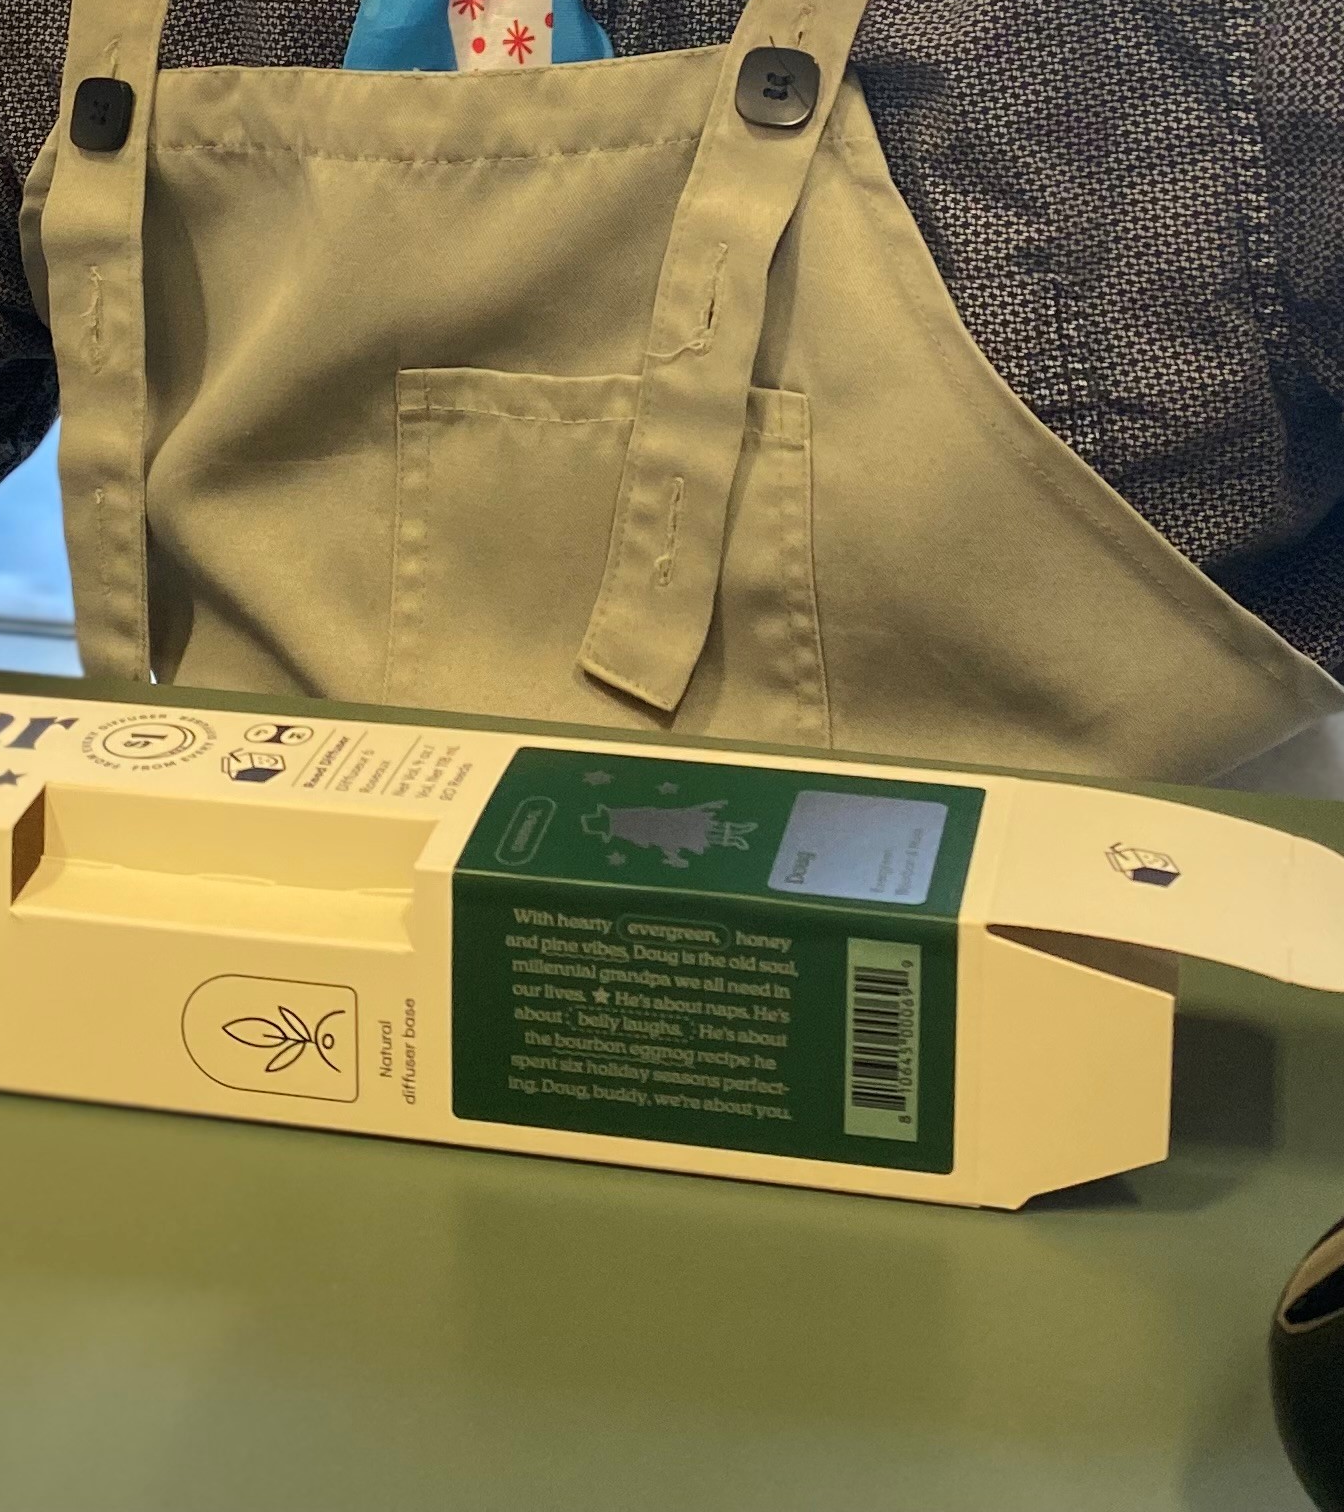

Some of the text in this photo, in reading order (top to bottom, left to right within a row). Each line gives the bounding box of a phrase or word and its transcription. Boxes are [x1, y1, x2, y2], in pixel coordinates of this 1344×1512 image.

[304, 736, 350, 788] Reed Diffuser
[513, 908, 554, 927] With
[557, 913, 612, 935] hearty
[735, 930, 792, 953] honey
[507, 935, 538, 949] and
[541, 938, 578, 955] pine
[634, 944, 679, 967] Doug
[682, 950, 697, 964] is
[699, 951, 726, 967] the
[729, 953, 756, 972] old
[512, 959, 791, 999] millennial grandpa we all need in
[512, 984, 541, 996] our
[615, 991, 651, 1009] He's
[654, 997, 702, 1013] about
[753, 1005, 790, 1023] He's
[514, 1006, 562, 1023] about
[578, 1012, 621, 1032] belly
[699, 1024, 735, 1041] He's
[737, 1028, 787, 1047] about
[378, 1020, 392, 1078] Natural
[401, 998, 416, 1105] diffuser base
[525, 1031, 777, 1070] the bourbon eggnog recipe he
[511, 1054, 557, 1071] spent
[559, 1058, 583, 1073] six
[586, 1060, 650, 1083] holiday
[653, 1070, 720, 1088] seasons
[655, 1094, 701, 1109] we're
[703, 1097, 753, 1117] about
